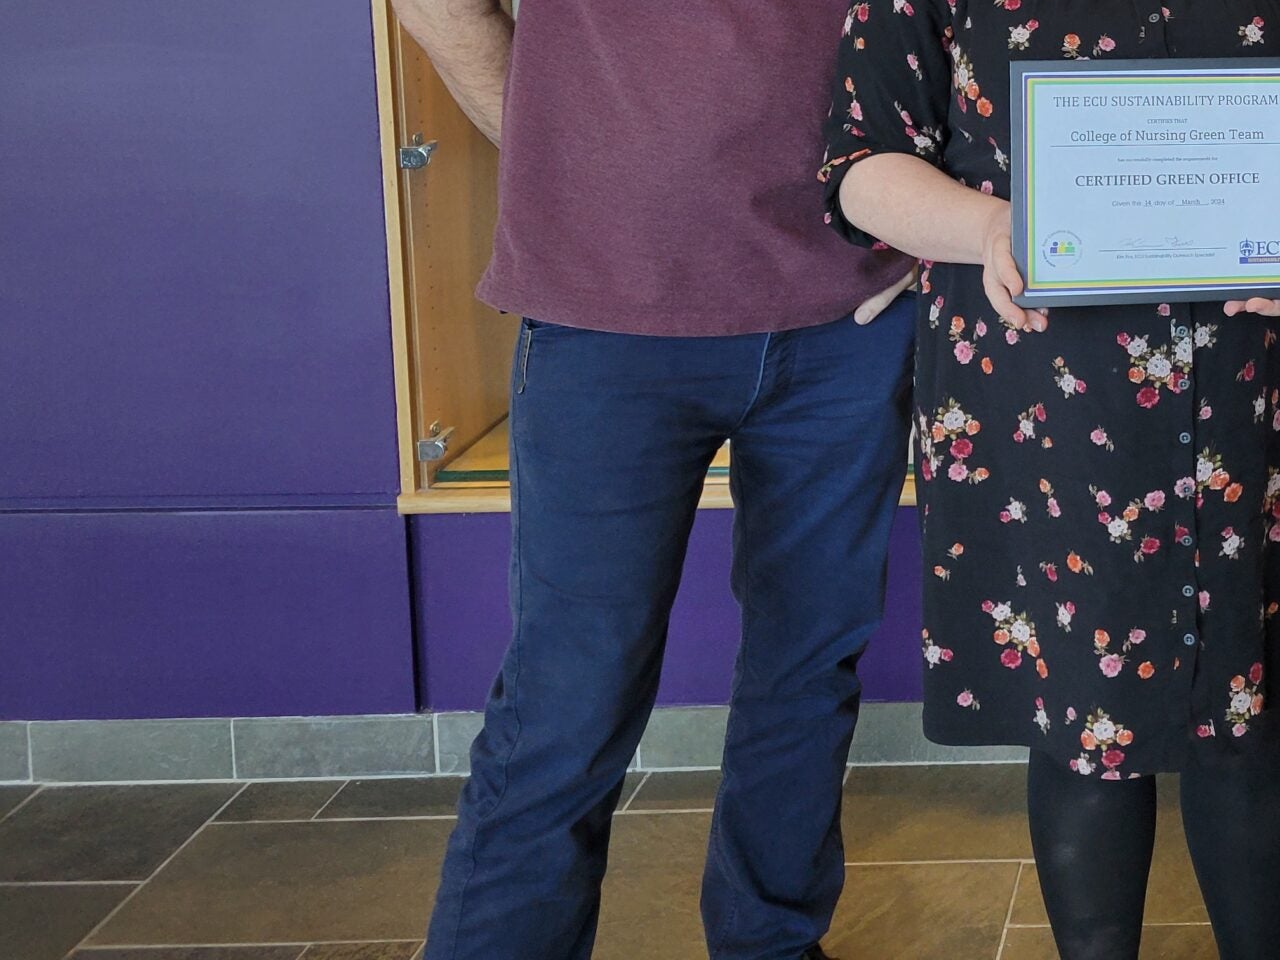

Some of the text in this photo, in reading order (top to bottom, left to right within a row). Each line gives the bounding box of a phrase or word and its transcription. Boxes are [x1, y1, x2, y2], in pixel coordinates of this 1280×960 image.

[1053, 94, 1279, 108] THE ECU SUSTAINABILITY PROGRAM
[1070, 128, 1265, 144] College of Nursing Green Team
[1075, 172, 1260, 187] CERTIFIED GREEN OFFICE
